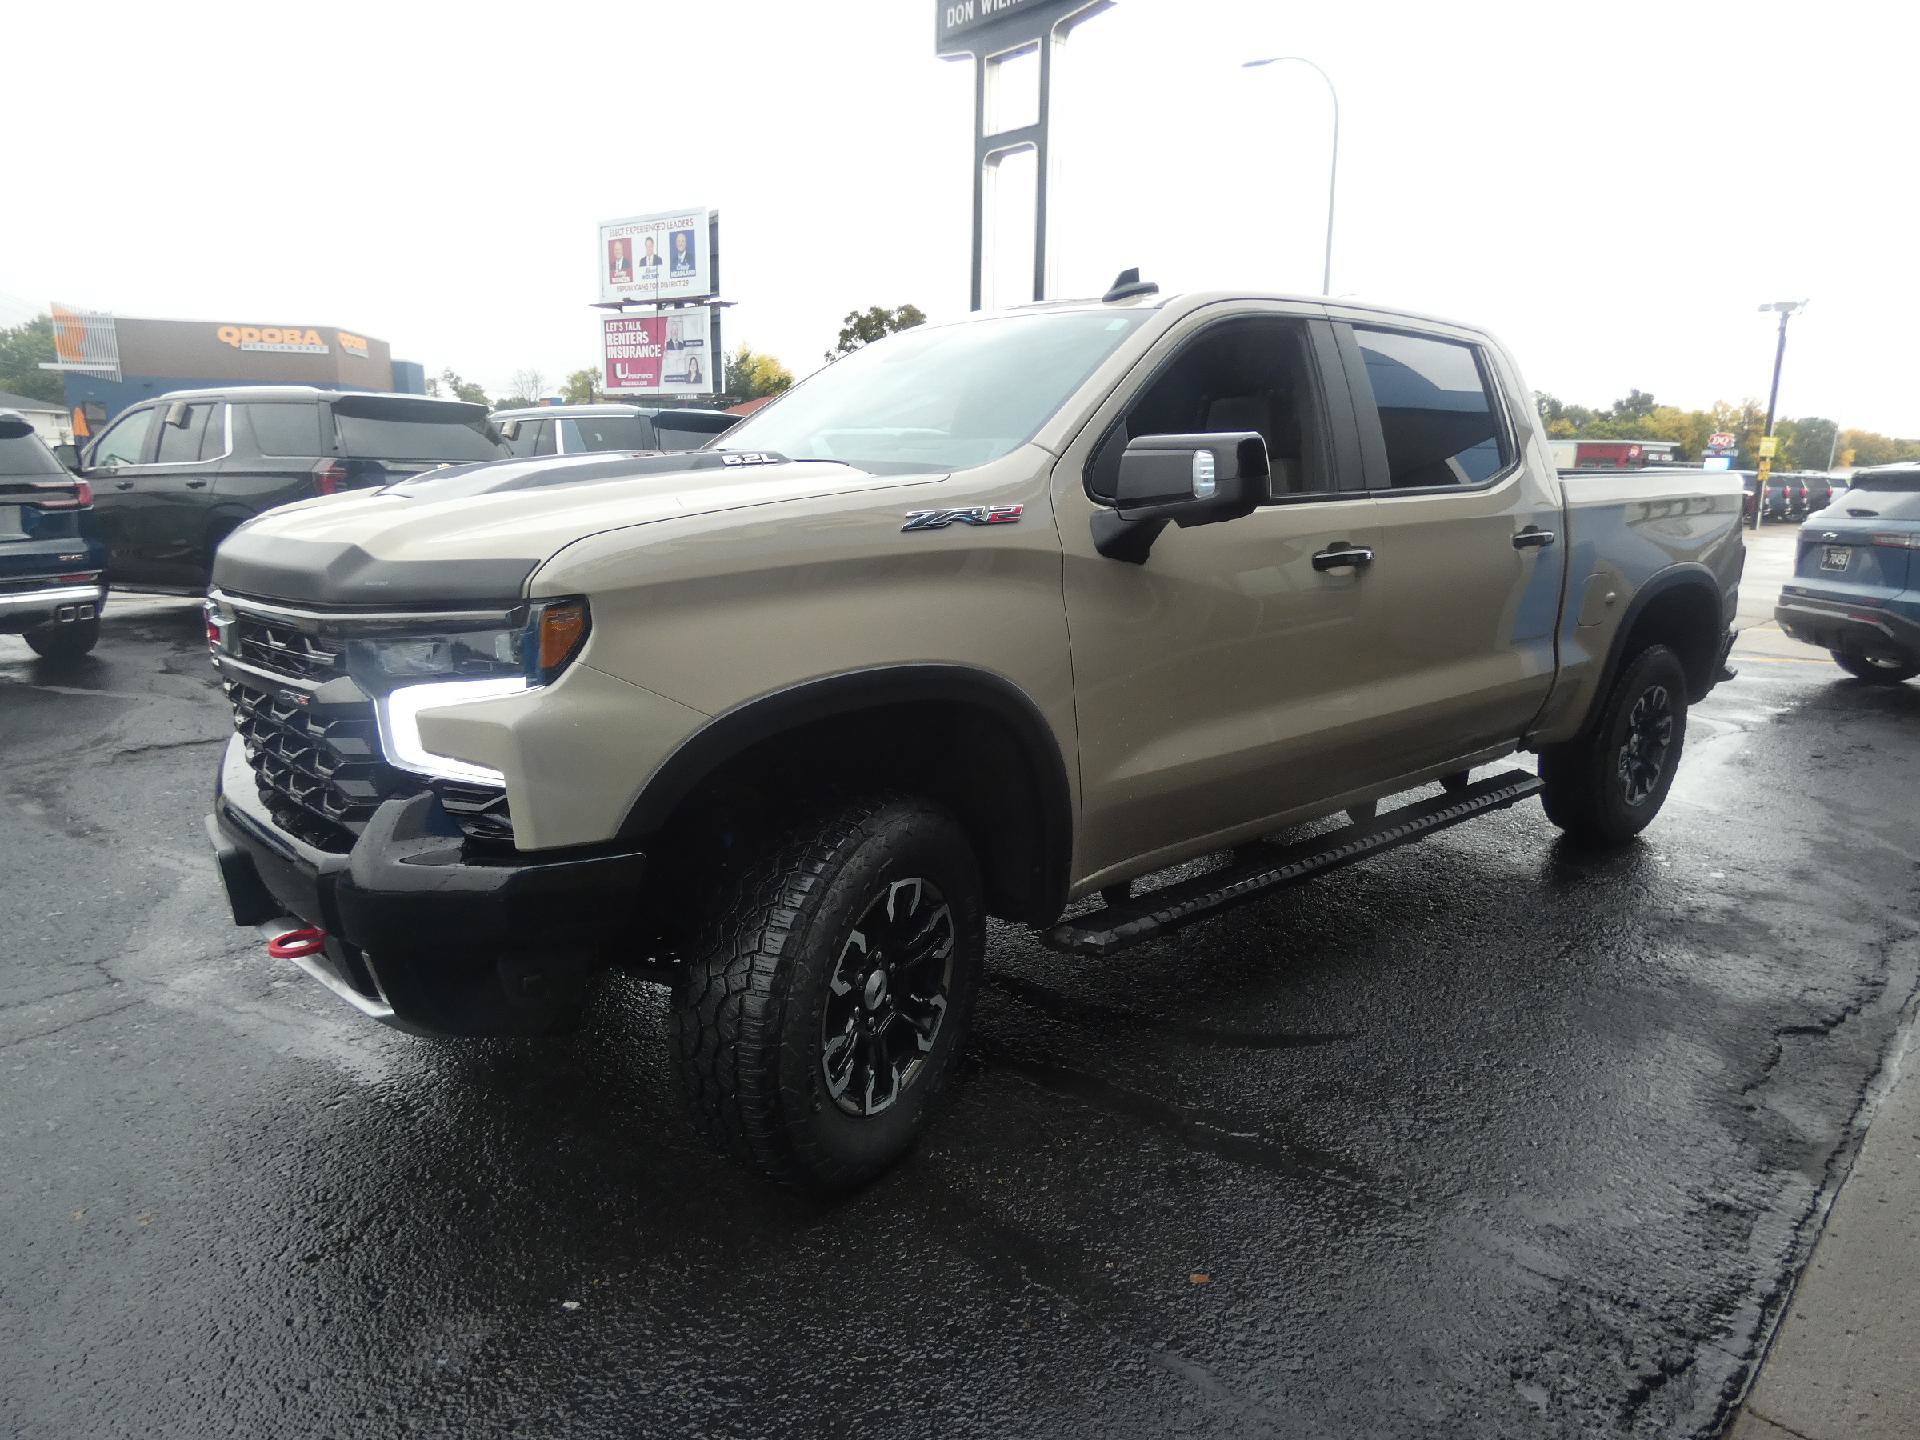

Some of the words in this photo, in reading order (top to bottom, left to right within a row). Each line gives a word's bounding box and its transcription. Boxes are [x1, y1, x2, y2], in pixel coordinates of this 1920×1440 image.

[946, 1, 974, 28] DON
[667, 217, 695, 230] LEADERS
[606, 321, 624, 332] LET'S
[625, 321, 641, 331] TALK
[217, 326, 324, 348] QDOBA
[606, 331, 649, 346] RENTERS
[607, 344, 662, 359] INSURANCE
[901, 504, 1024, 532] ZR2
